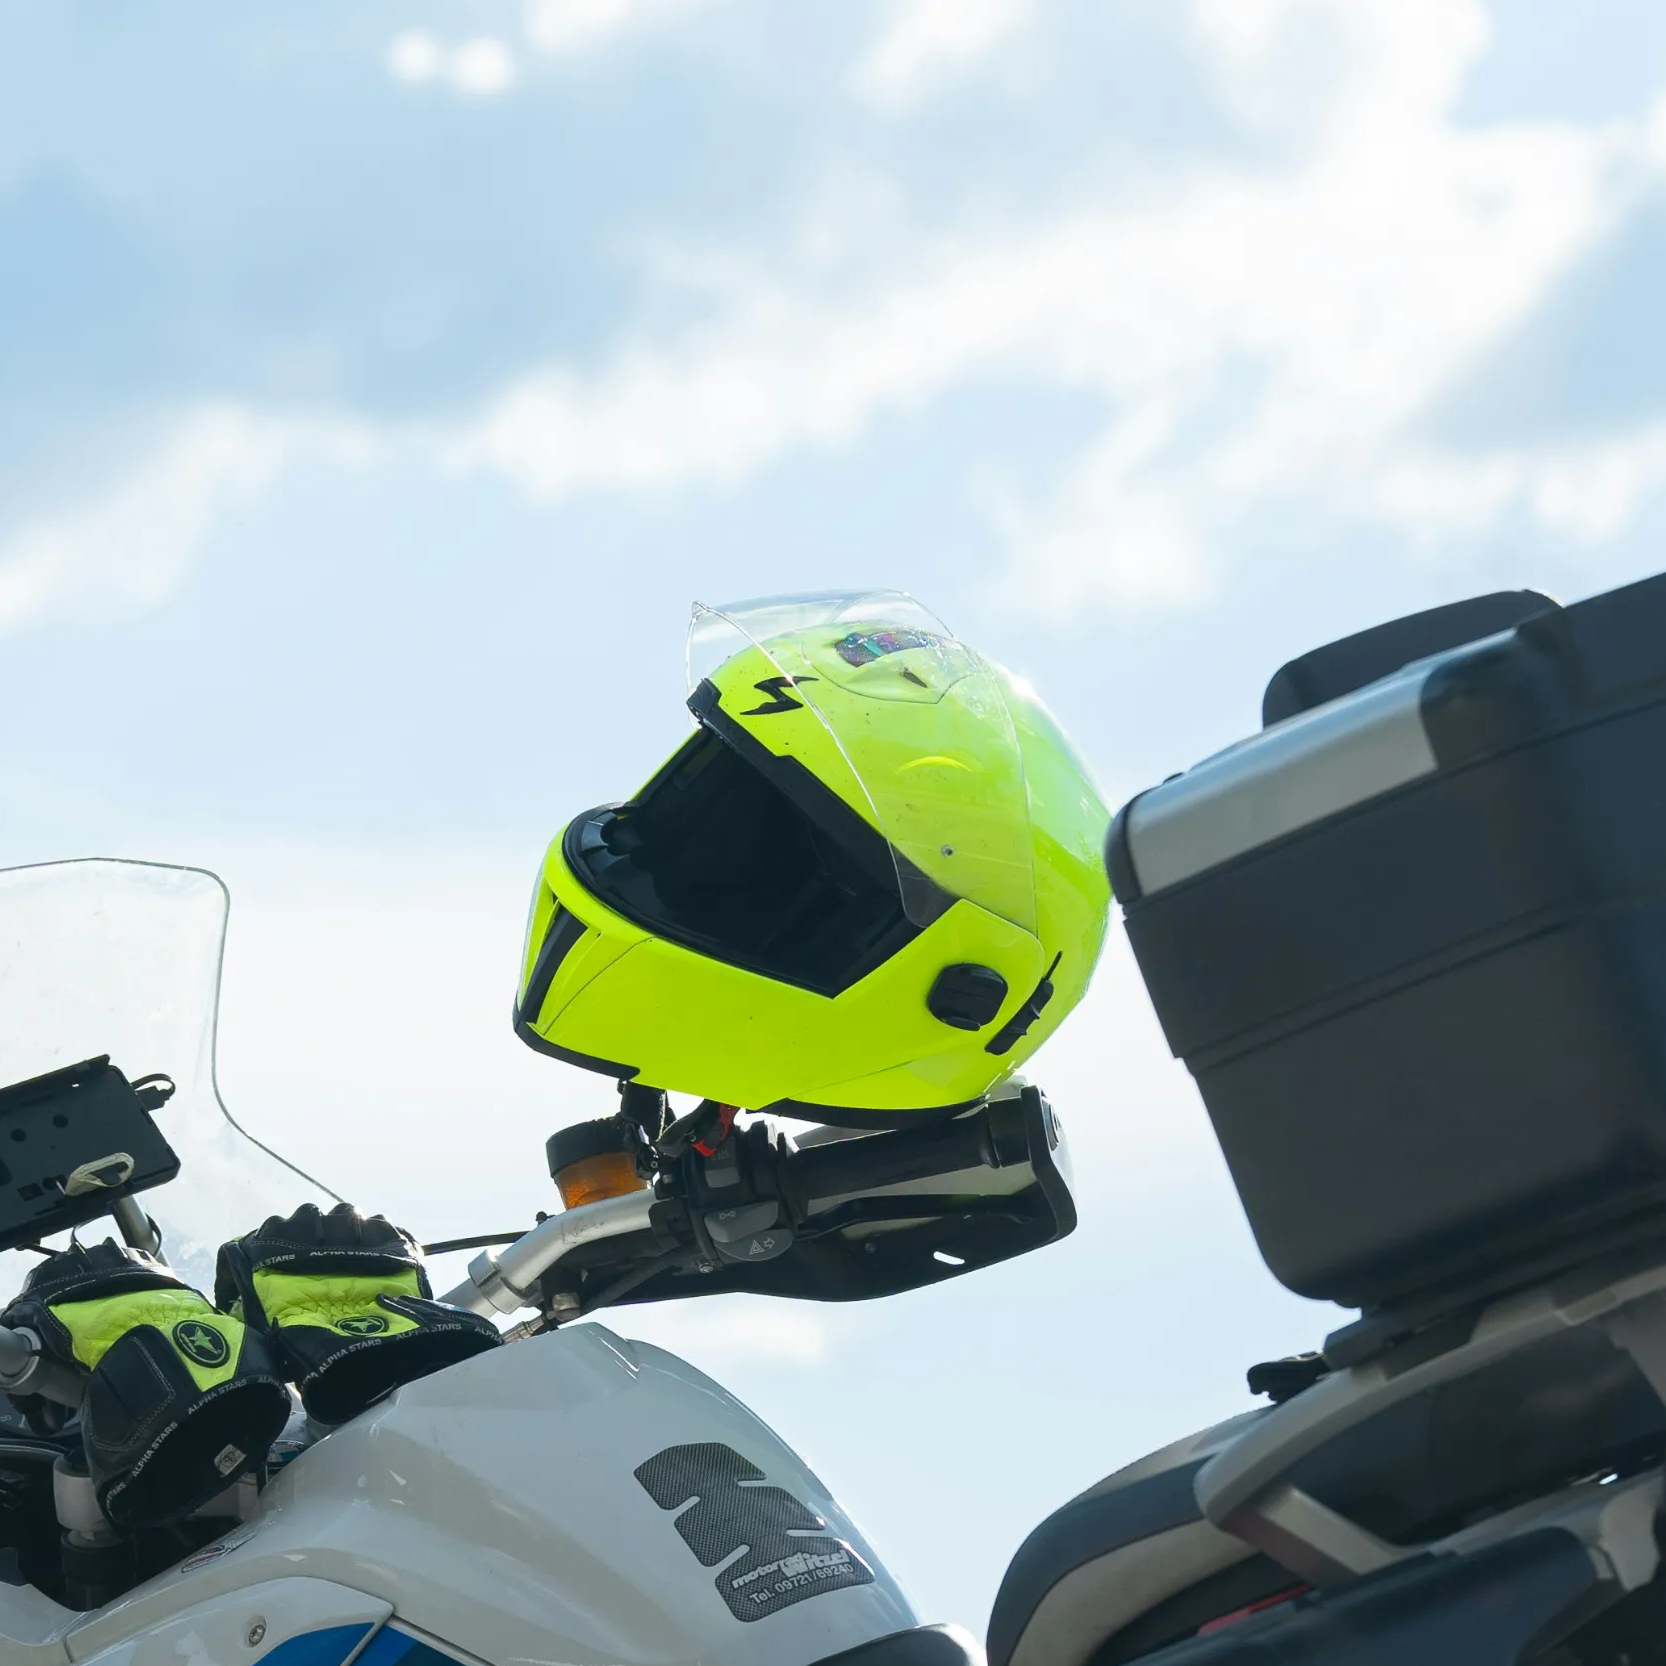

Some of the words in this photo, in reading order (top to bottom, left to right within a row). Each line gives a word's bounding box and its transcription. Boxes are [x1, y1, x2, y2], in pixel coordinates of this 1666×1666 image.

[319, 1349, 349, 1373] ALPHA
[348, 1337, 382, 1353] STARS
[395, 1325, 429, 1341] ALPHA
[431, 1323, 462, 1333] STARS
[132, 1449, 155, 1478] ALPHA
[151, 1421, 179, 1450] STARS
[187, 1391, 218, 1415] ALPHA
[218, 1378, 247, 1396] STARS
[749, 1589, 775, 1603] Tel.
[774, 1563, 854, 1593] 09721/69240
